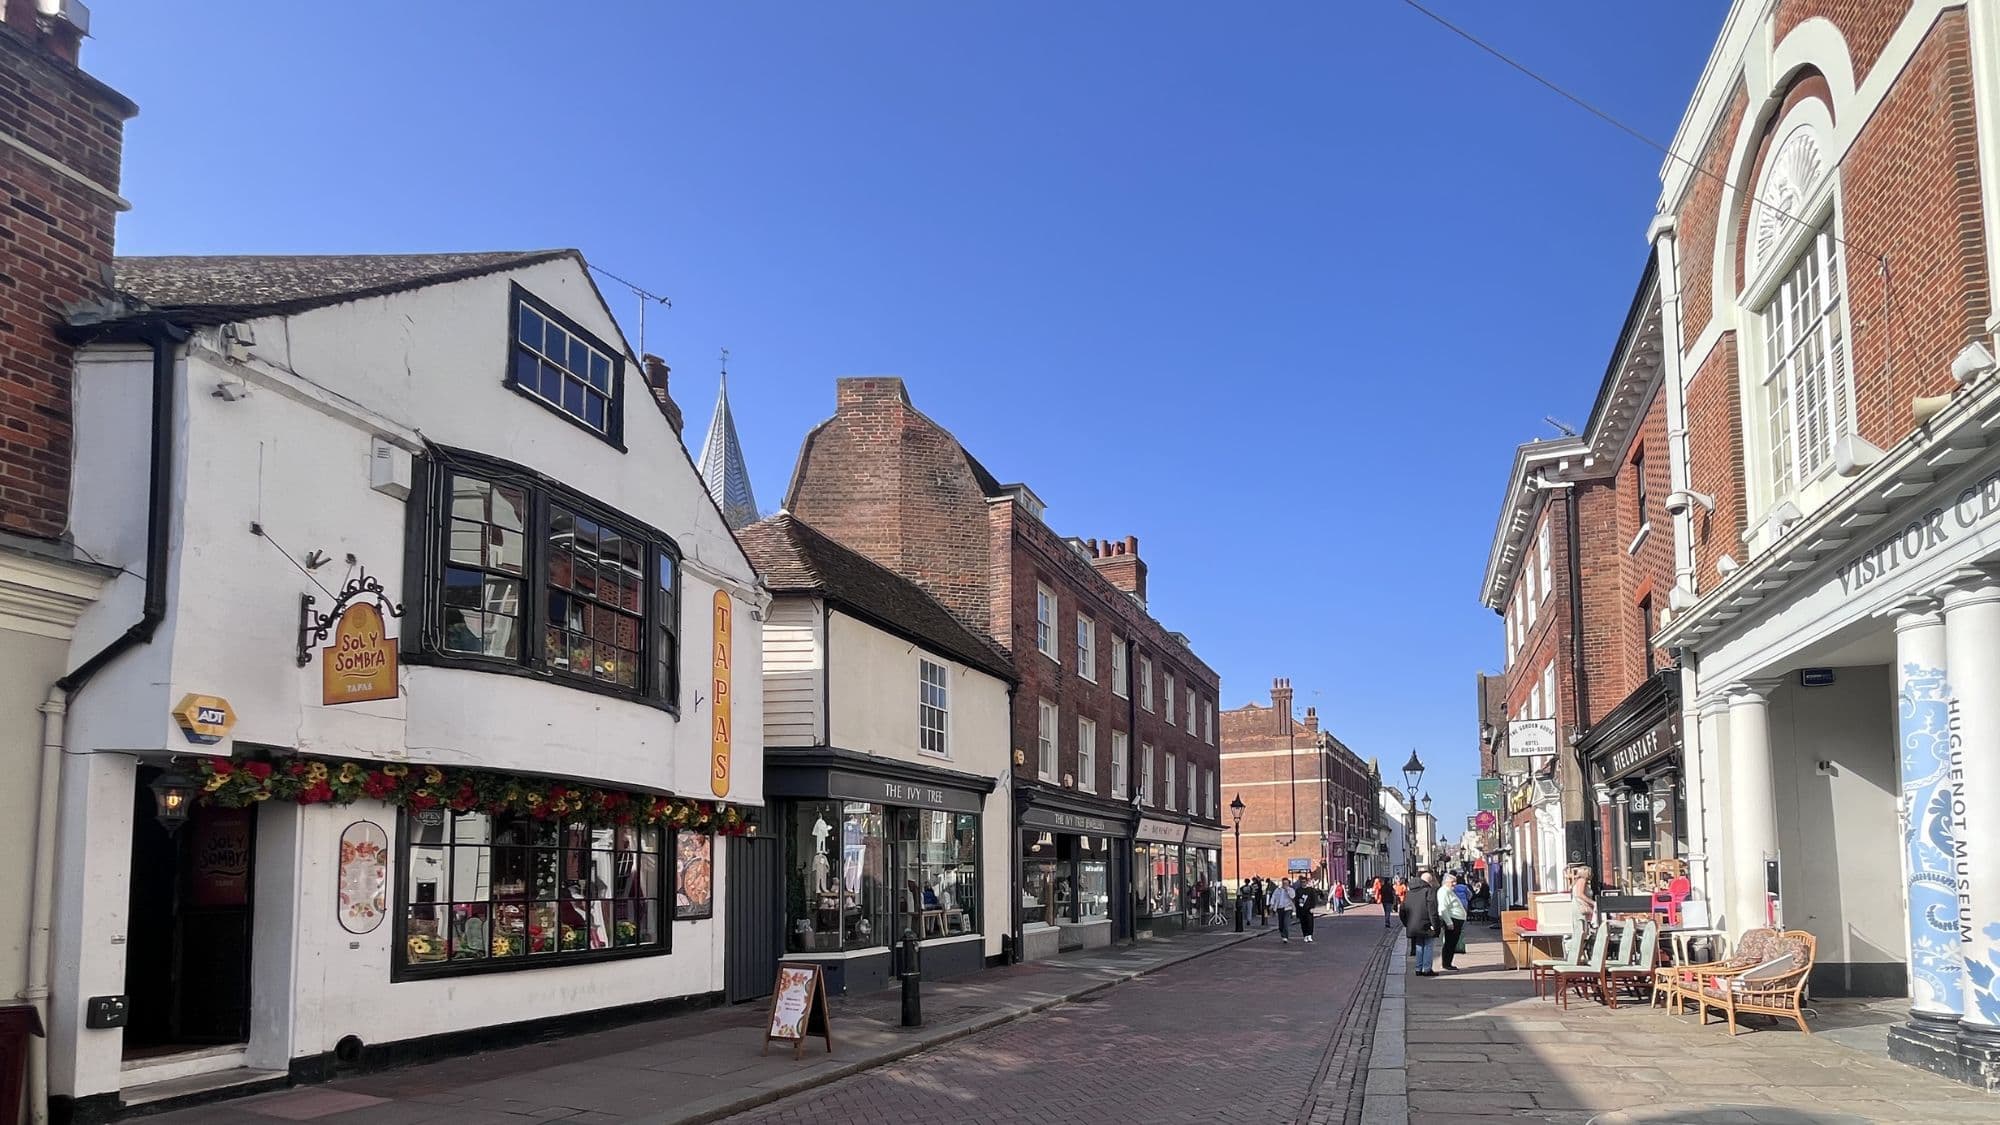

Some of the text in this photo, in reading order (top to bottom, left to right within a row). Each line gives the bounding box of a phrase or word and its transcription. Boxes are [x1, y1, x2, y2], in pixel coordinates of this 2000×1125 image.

[1836, 507, 1949, 597] VISITOR
[369, 631, 378, 648] Y
[715, 606, 729, 780] TAPAS
[198, 709, 226, 724] ADT
[1613, 730, 1658, 771] FIELDSTAFF
[885, 783, 943, 804] THE IVY TREE
[419, 811, 441, 820] OPEN
[1055, 813, 1064, 825] THE
[1948, 698, 1974, 943] HUGUENOT MUSEUM
